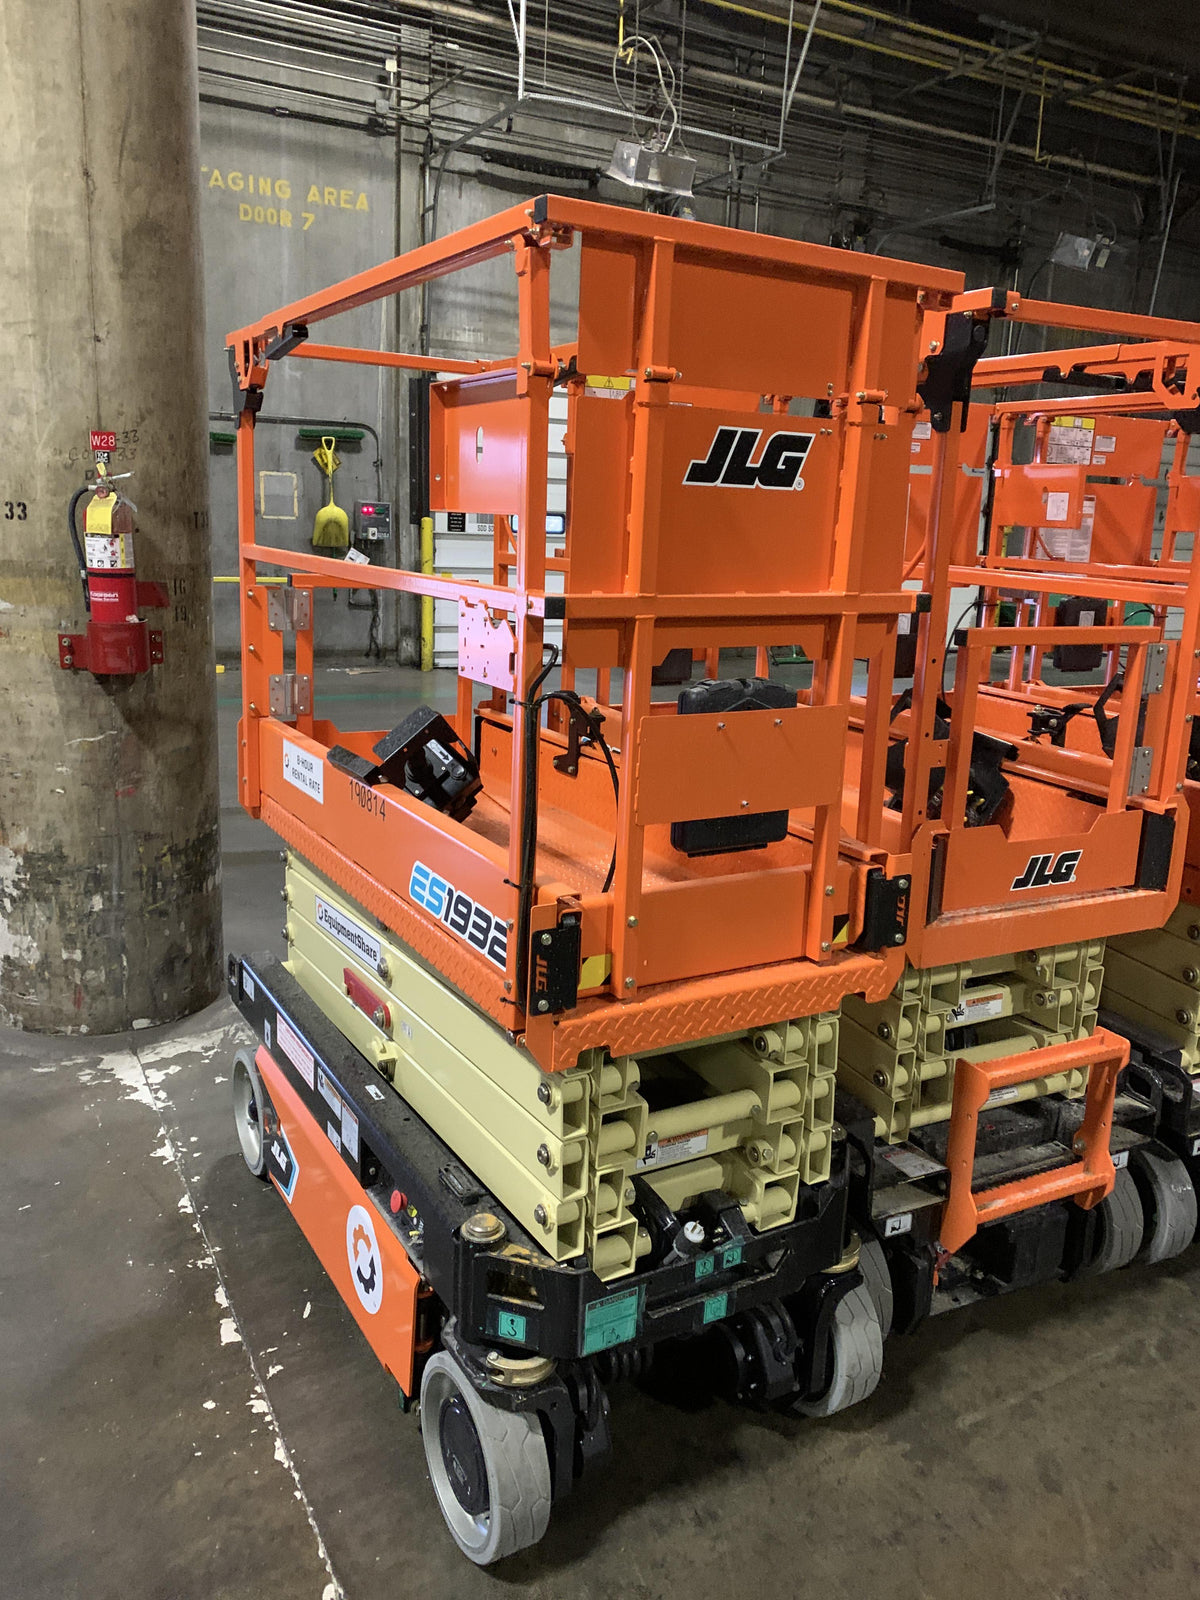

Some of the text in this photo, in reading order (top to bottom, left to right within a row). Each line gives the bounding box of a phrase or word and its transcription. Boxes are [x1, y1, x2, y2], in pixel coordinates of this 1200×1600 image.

[201, 164, 369, 211] AGING AREA
[239, 203, 315, 230] DOOR 7
[91, 435, 116, 447] W28
[682, 425, 816, 491] JLG
[4, 501, 28, 520] 33
[291, 766, 321, 794] RENTAL RATE
[349, 779, 386, 821] 190814
[1010, 849, 1083, 891] JLG
[895, 893, 907, 926] JLG
[323, 908, 378, 963] EquipmentShare
[535, 954, 549, 993] JLG
[271, 1141, 287, 1173] JLG
